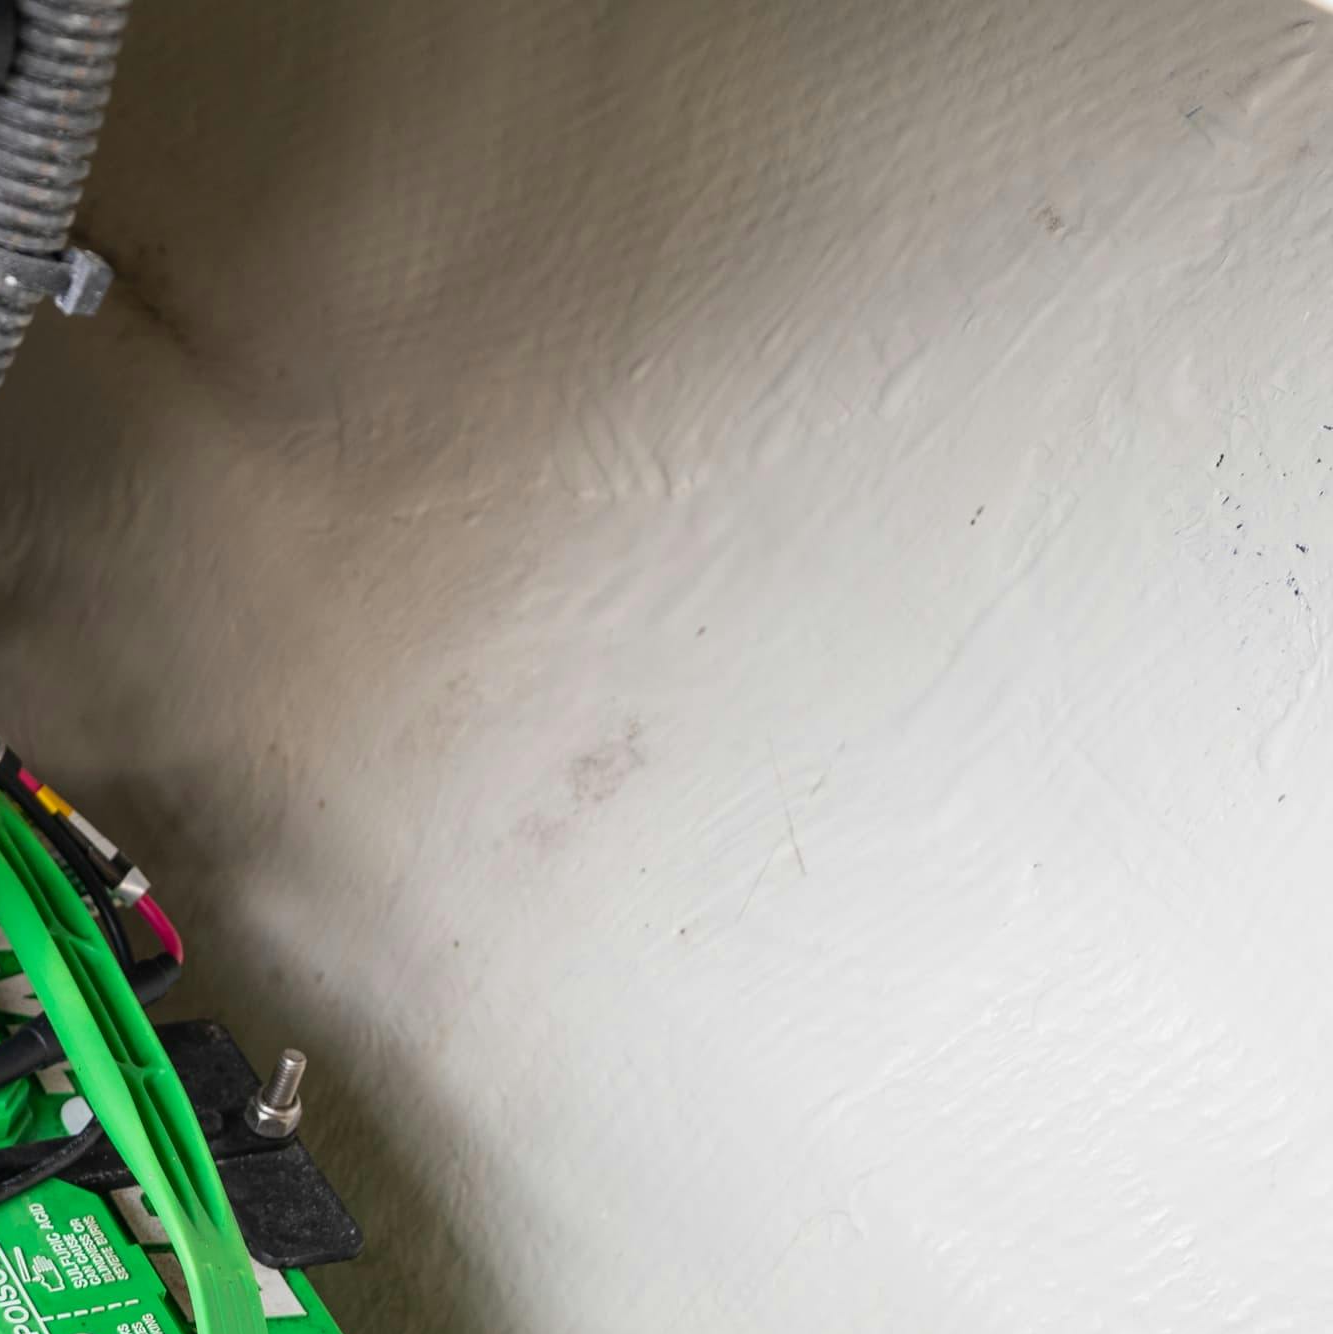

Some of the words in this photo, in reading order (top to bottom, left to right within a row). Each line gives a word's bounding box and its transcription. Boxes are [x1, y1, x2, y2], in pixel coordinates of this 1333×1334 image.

[28, 1204, 53, 1229] ACID
[69, 1218, 85, 1232] OR
[83, 1215, 107, 1245] BURNS
[46, 1232, 87, 1288] SULFURIC
[62, 1233, 88, 1264] CAUSE
[79, 1233, 114, 1282] BLINDNESS
[100, 1246, 128, 1280] SEVERE
[81, 1264, 101, 1285] CAN
